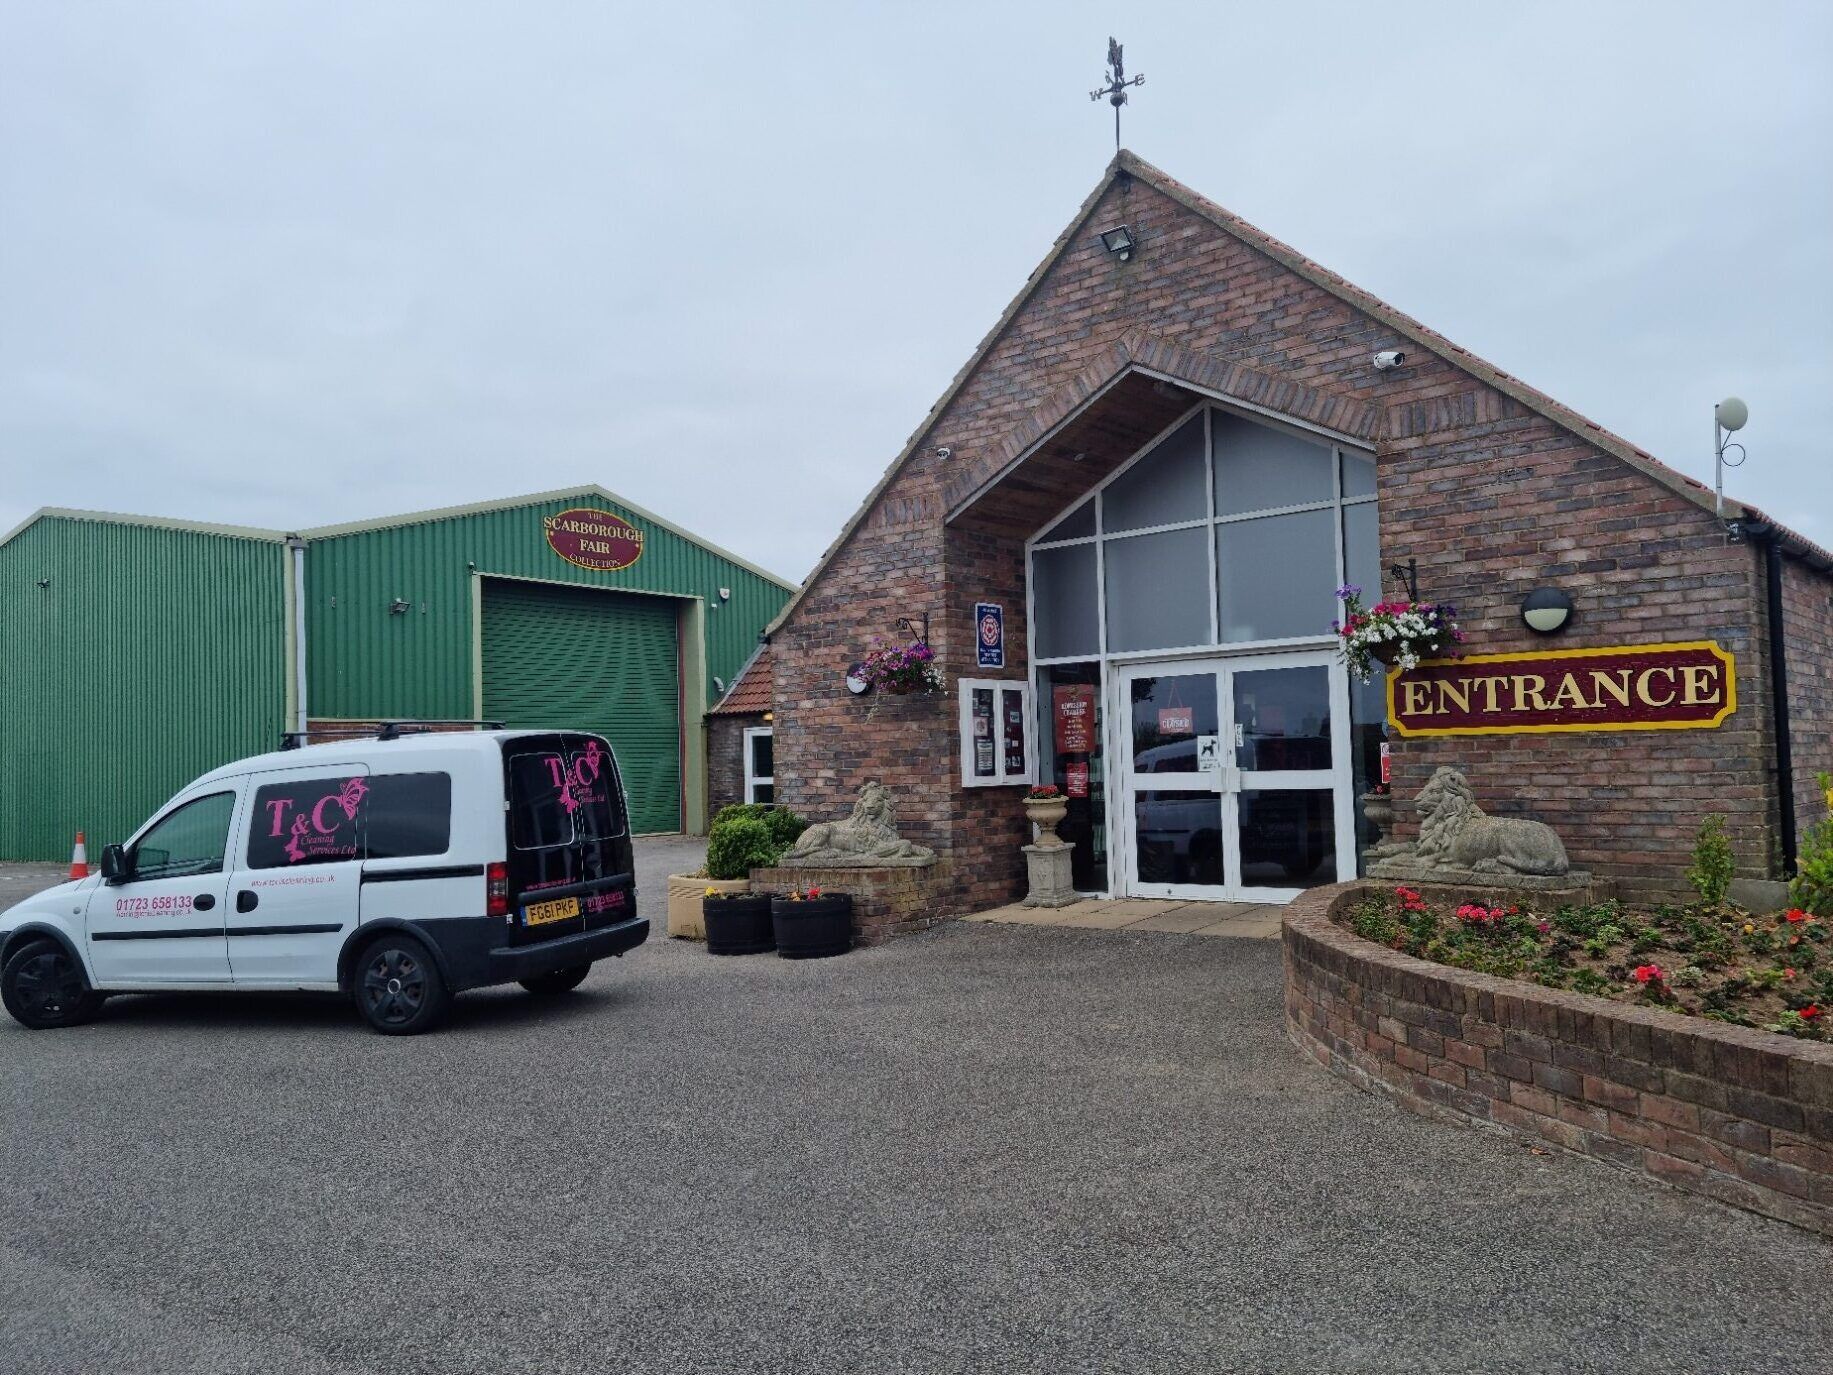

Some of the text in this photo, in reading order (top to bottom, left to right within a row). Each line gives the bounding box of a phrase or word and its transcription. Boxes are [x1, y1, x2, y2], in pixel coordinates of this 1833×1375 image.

[1089, 87, 1104, 102] W
[588, 512, 603, 521] THE
[543, 516, 644, 542] SCARBOROUGH
[580, 538, 611, 554] FAIR
[569, 552, 621, 568] COLLECTION
[1401, 664, 1721, 717] ENTRANCE
[1162, 717, 1190, 729] CLOSED
[300, 833, 335, 846] Cleaning
[308, 843, 357, 856] Services Ltd
[116, 895, 192, 911] 01723 658133
[530, 904, 555, 921] FG61
[556, 899, 575, 917] PKF
